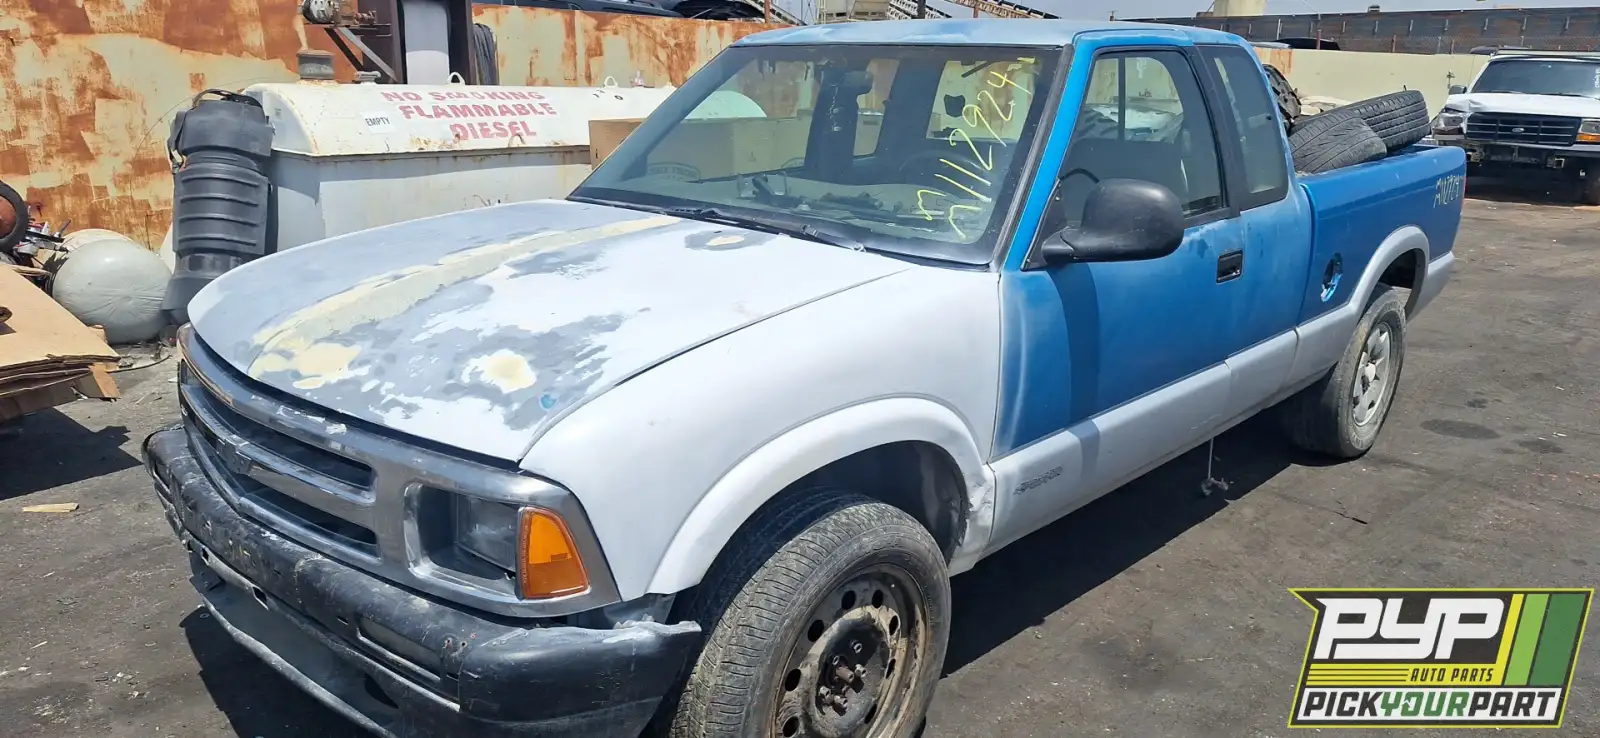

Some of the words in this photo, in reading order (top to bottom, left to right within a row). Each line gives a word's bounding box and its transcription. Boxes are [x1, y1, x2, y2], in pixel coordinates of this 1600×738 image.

[381, 92, 423, 101] NO
[429, 91, 546, 101] SMOKING
[398, 102, 557, 119] FLAMMABLE
[365, 117, 391, 127] EMPTY
[449, 120, 537, 141] DIESEL
